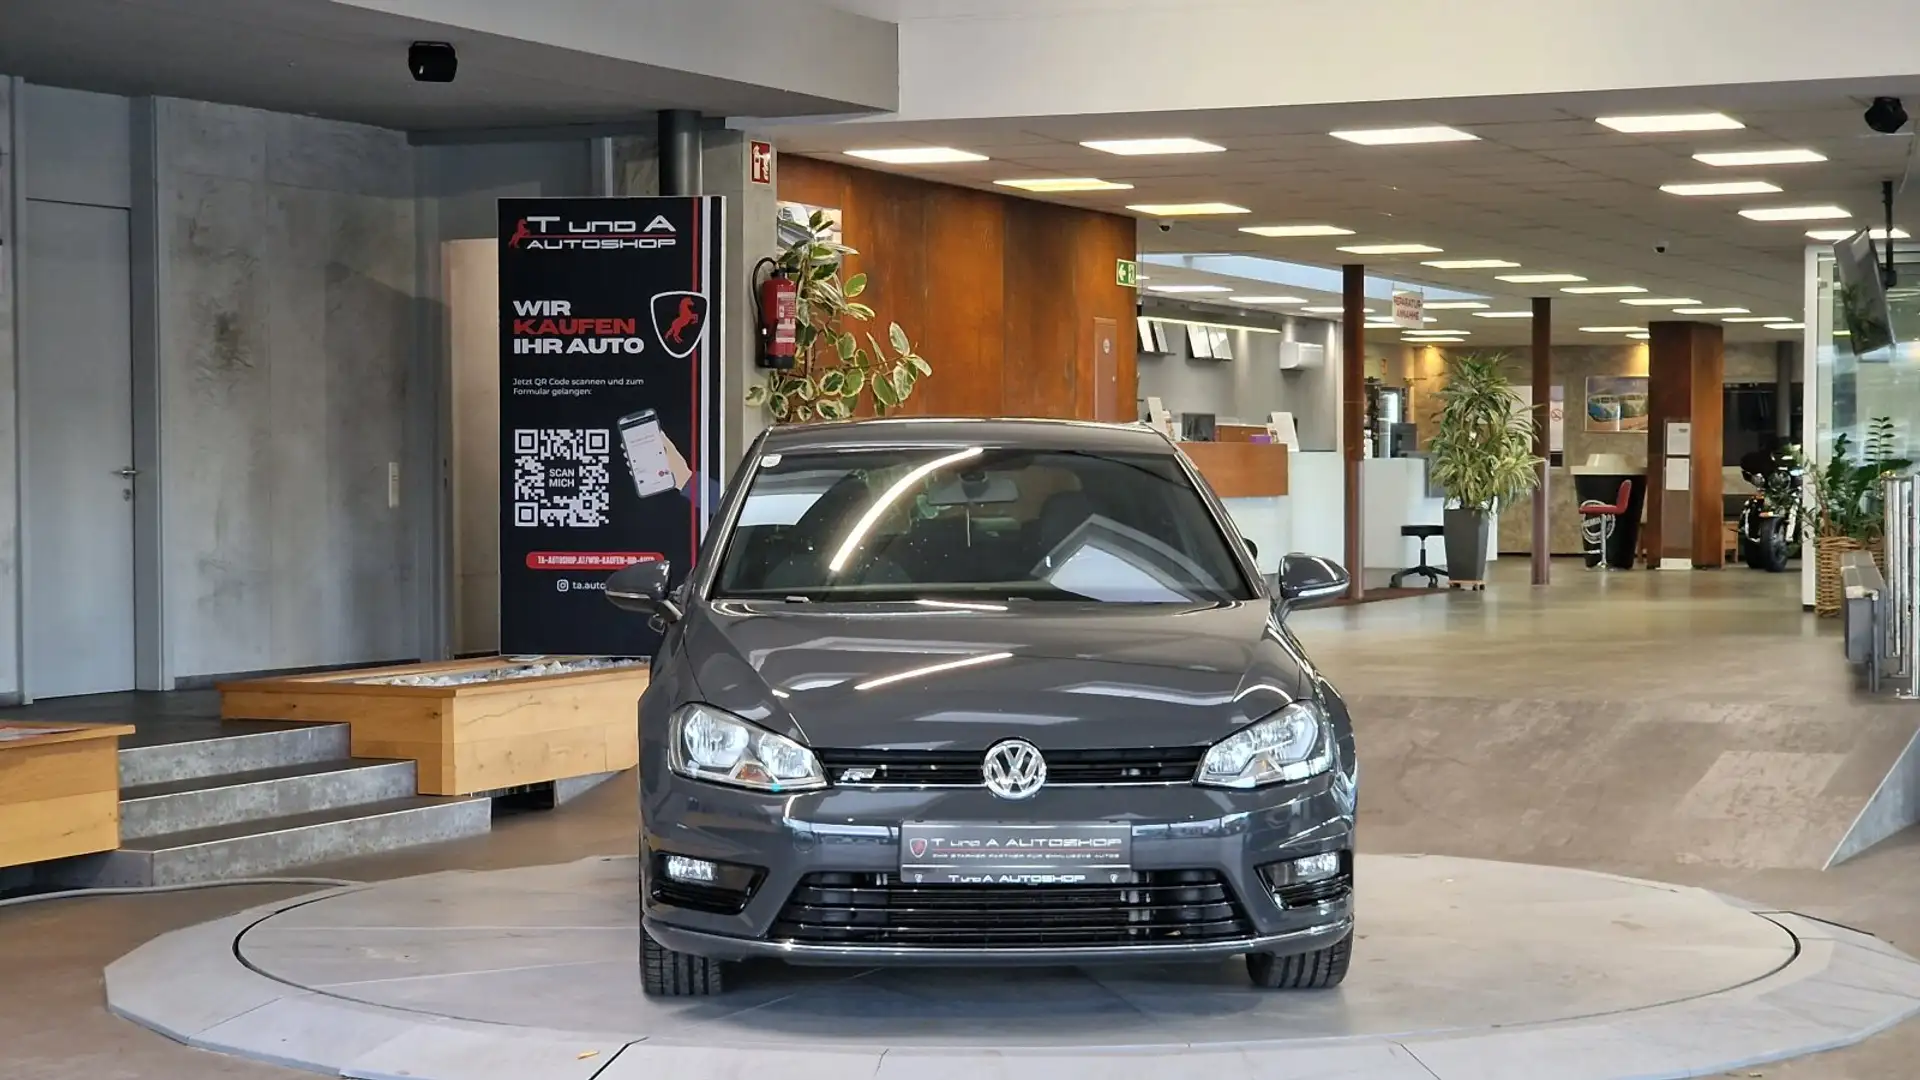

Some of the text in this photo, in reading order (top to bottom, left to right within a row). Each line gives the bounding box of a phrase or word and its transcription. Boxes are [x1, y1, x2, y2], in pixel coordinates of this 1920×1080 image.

[527, 216, 560, 233] T
[643, 215, 677, 232] A
[526, 239, 677, 249] AUTOSHOP
[513, 300, 571, 317] WIR
[513, 318, 636, 335] KAUFEN
[513, 338, 645, 354] IHR AUTO
[512, 378, 533, 386] Jetzt
[534, 378, 547, 386] QR
[549, 378, 570, 386] Code
[607, 378, 624, 386] und
[513, 387, 592, 397] Formular gelangen:
[549, 468, 575, 477] SCAN
[549, 478, 575, 487] MICH
[930, 838, 945, 846] T
[985, 838, 1000, 847] A
[1006, 838, 1122, 847] AUTOSHOP
[999, 874, 1086, 883] AUTOSHOP
